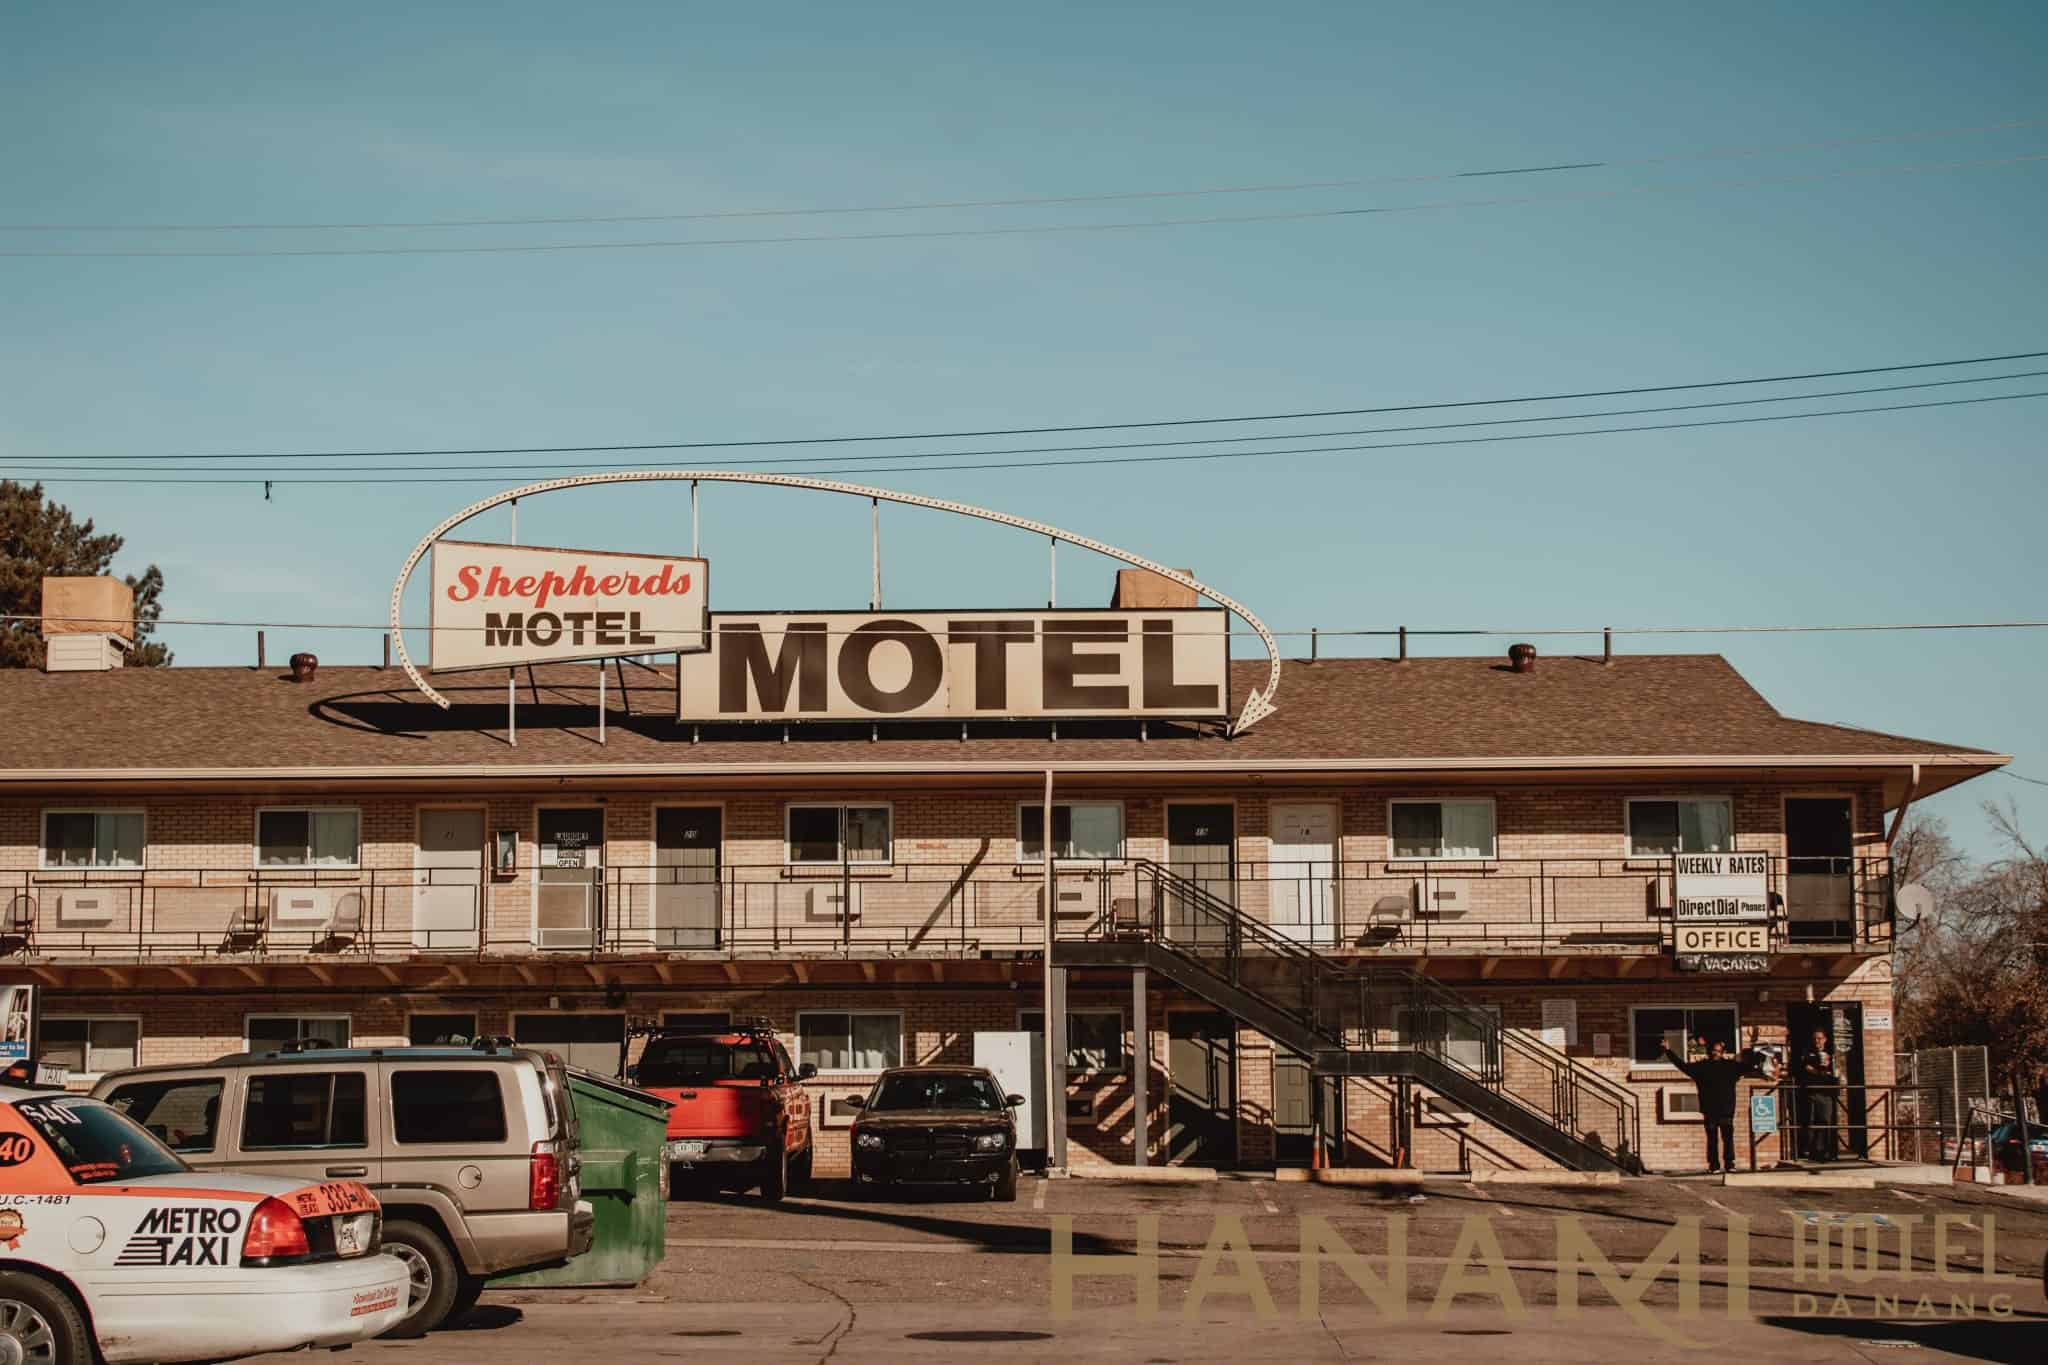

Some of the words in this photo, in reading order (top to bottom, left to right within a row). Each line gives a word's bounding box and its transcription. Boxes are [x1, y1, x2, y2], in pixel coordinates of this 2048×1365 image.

[447, 564, 691, 609] Shepherds
[485, 611, 655, 647] MOTEL
[719, 618, 1218, 714] MOTEL
[1679, 857, 1721, 874] WEEKLY
[1729, 857, 1764, 873] RATES
[1685, 931, 1761, 948] OFFICE
[1704, 958, 1767, 970] VACANCY
[43, 1066, 64, 1084] TAXI
[135, 1207, 241, 1234] METRO
[132, 1236, 229, 1265] TAXI
